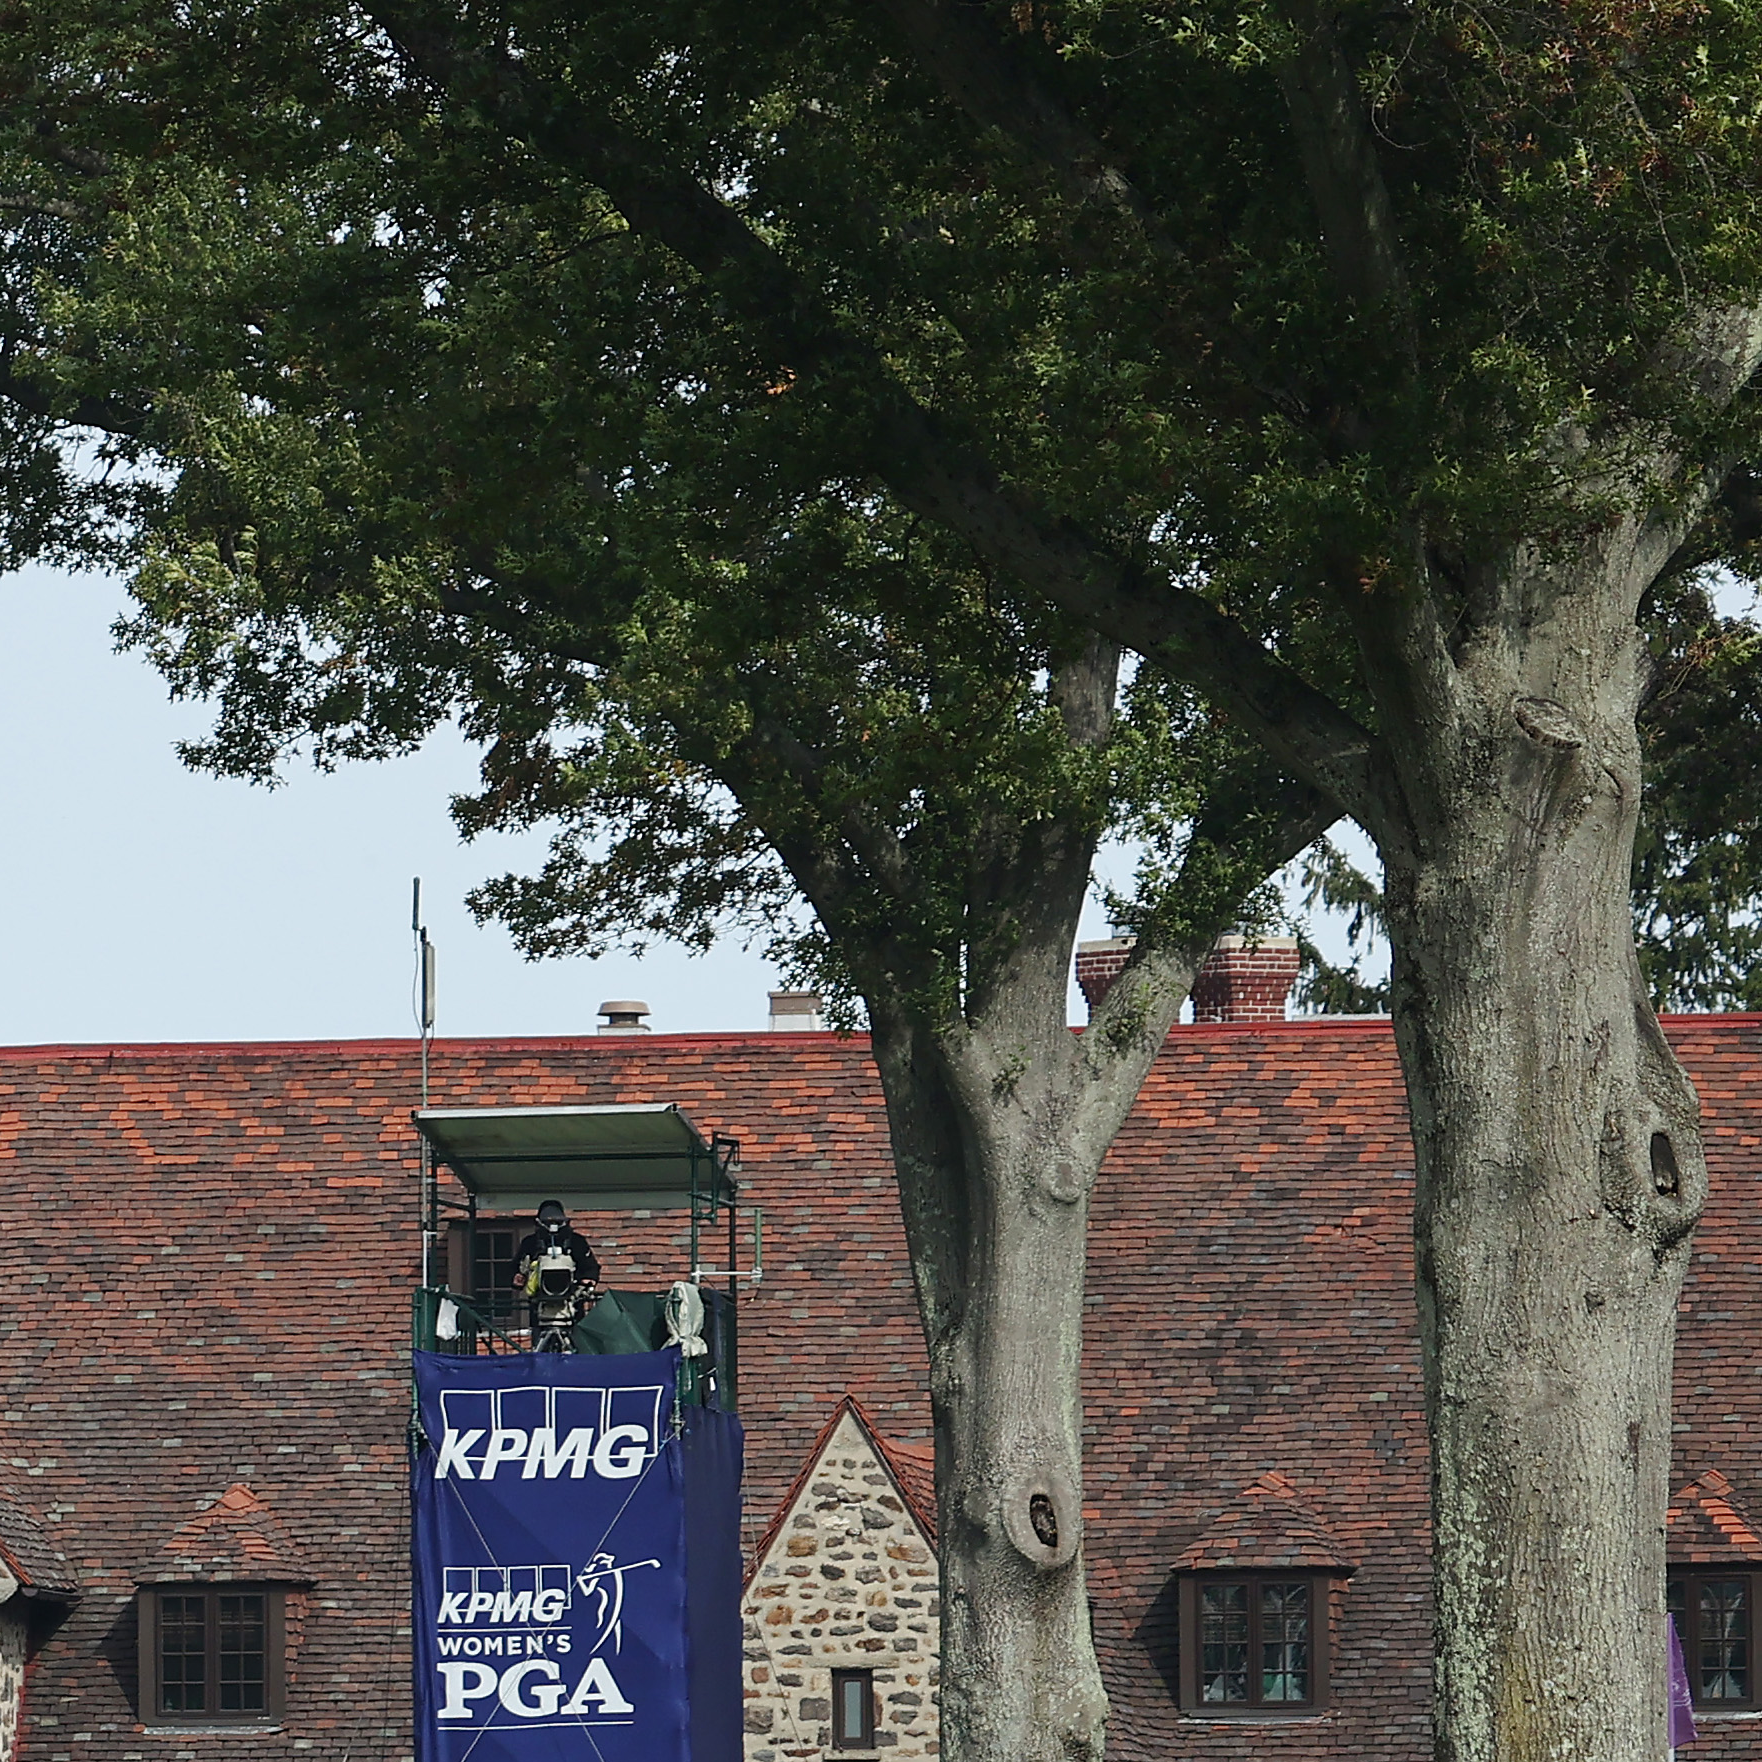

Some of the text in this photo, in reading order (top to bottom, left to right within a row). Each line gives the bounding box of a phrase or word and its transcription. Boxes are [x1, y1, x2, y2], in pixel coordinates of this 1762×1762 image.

[435, 1424, 649, 1480] KPMG
[437, 1588, 567, 1624] KPMG
[437, 1634, 572, 1656] WOMEN'S
[437, 1657, 634, 1719] PGA
